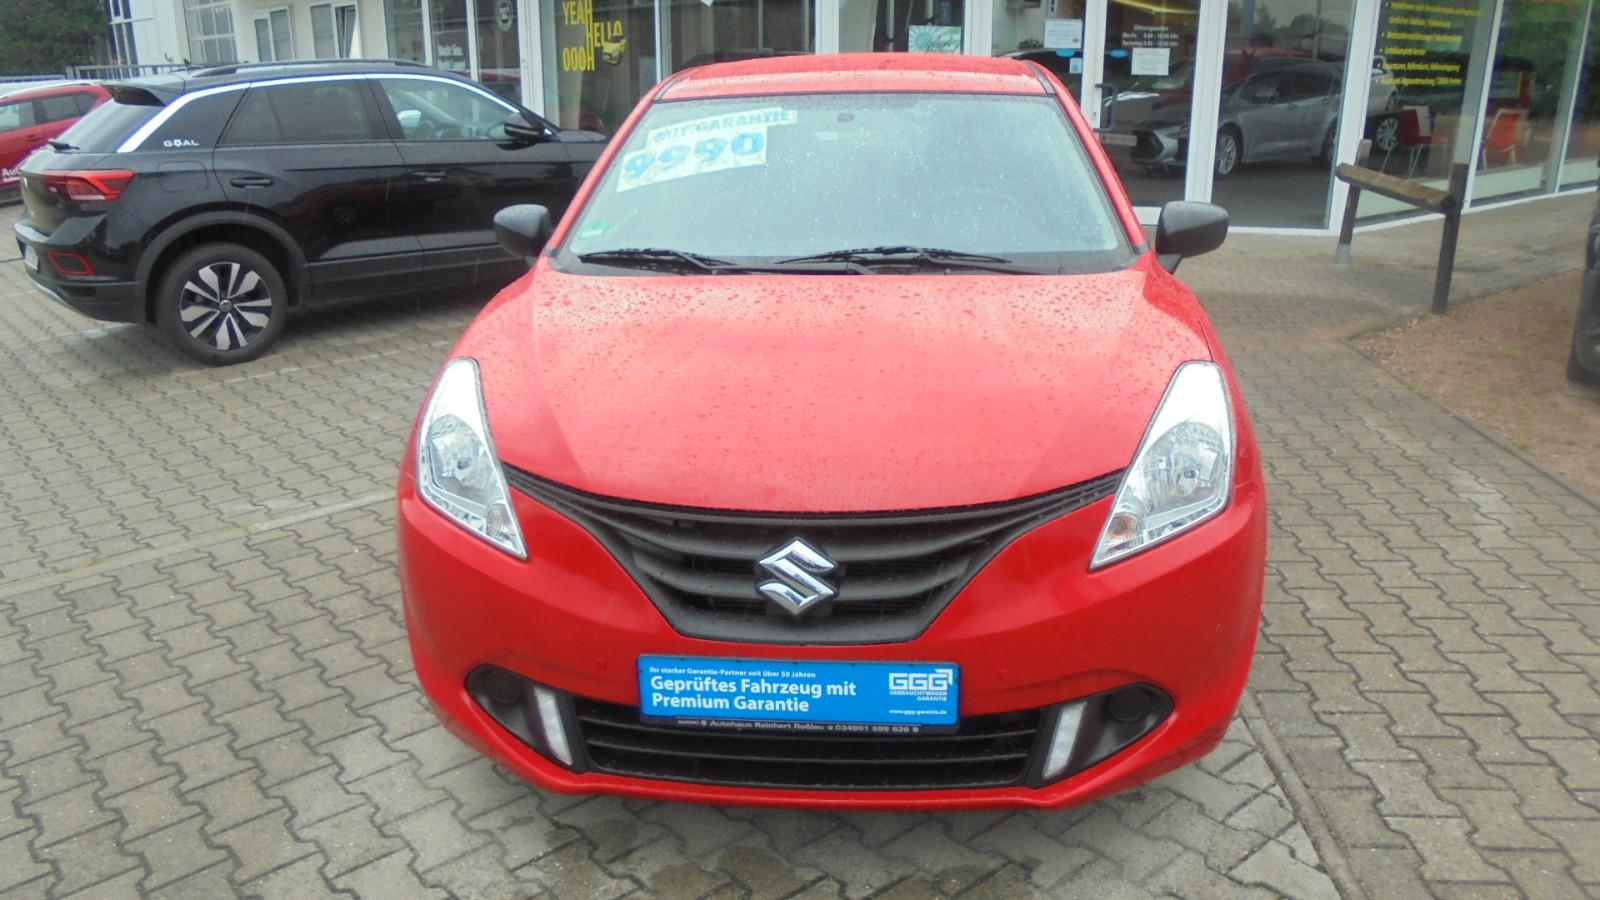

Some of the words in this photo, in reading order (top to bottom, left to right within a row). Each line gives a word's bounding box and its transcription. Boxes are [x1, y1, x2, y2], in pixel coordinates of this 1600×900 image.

[562, 0, 593, 25] YEAH
[563, 47, 595, 71] OOOH
[654, 127, 688, 142] MIT
[695, 110, 791, 132] GARANTIE
[163, 139, 200, 147] GOAL
[624, 132, 765, 177] 9990
[687, 668, 746, 676] Garantie-Partner
[889, 672, 948, 690] GGG
[650, 675, 737, 693] Geprüftes
[741, 678, 822, 698] Fahrzeug
[827, 681, 857, 695] mit
[652, 693, 730, 709] Premium
[734, 695, 809, 712] Garantie
[710, 720, 752, 728] Autohaus
